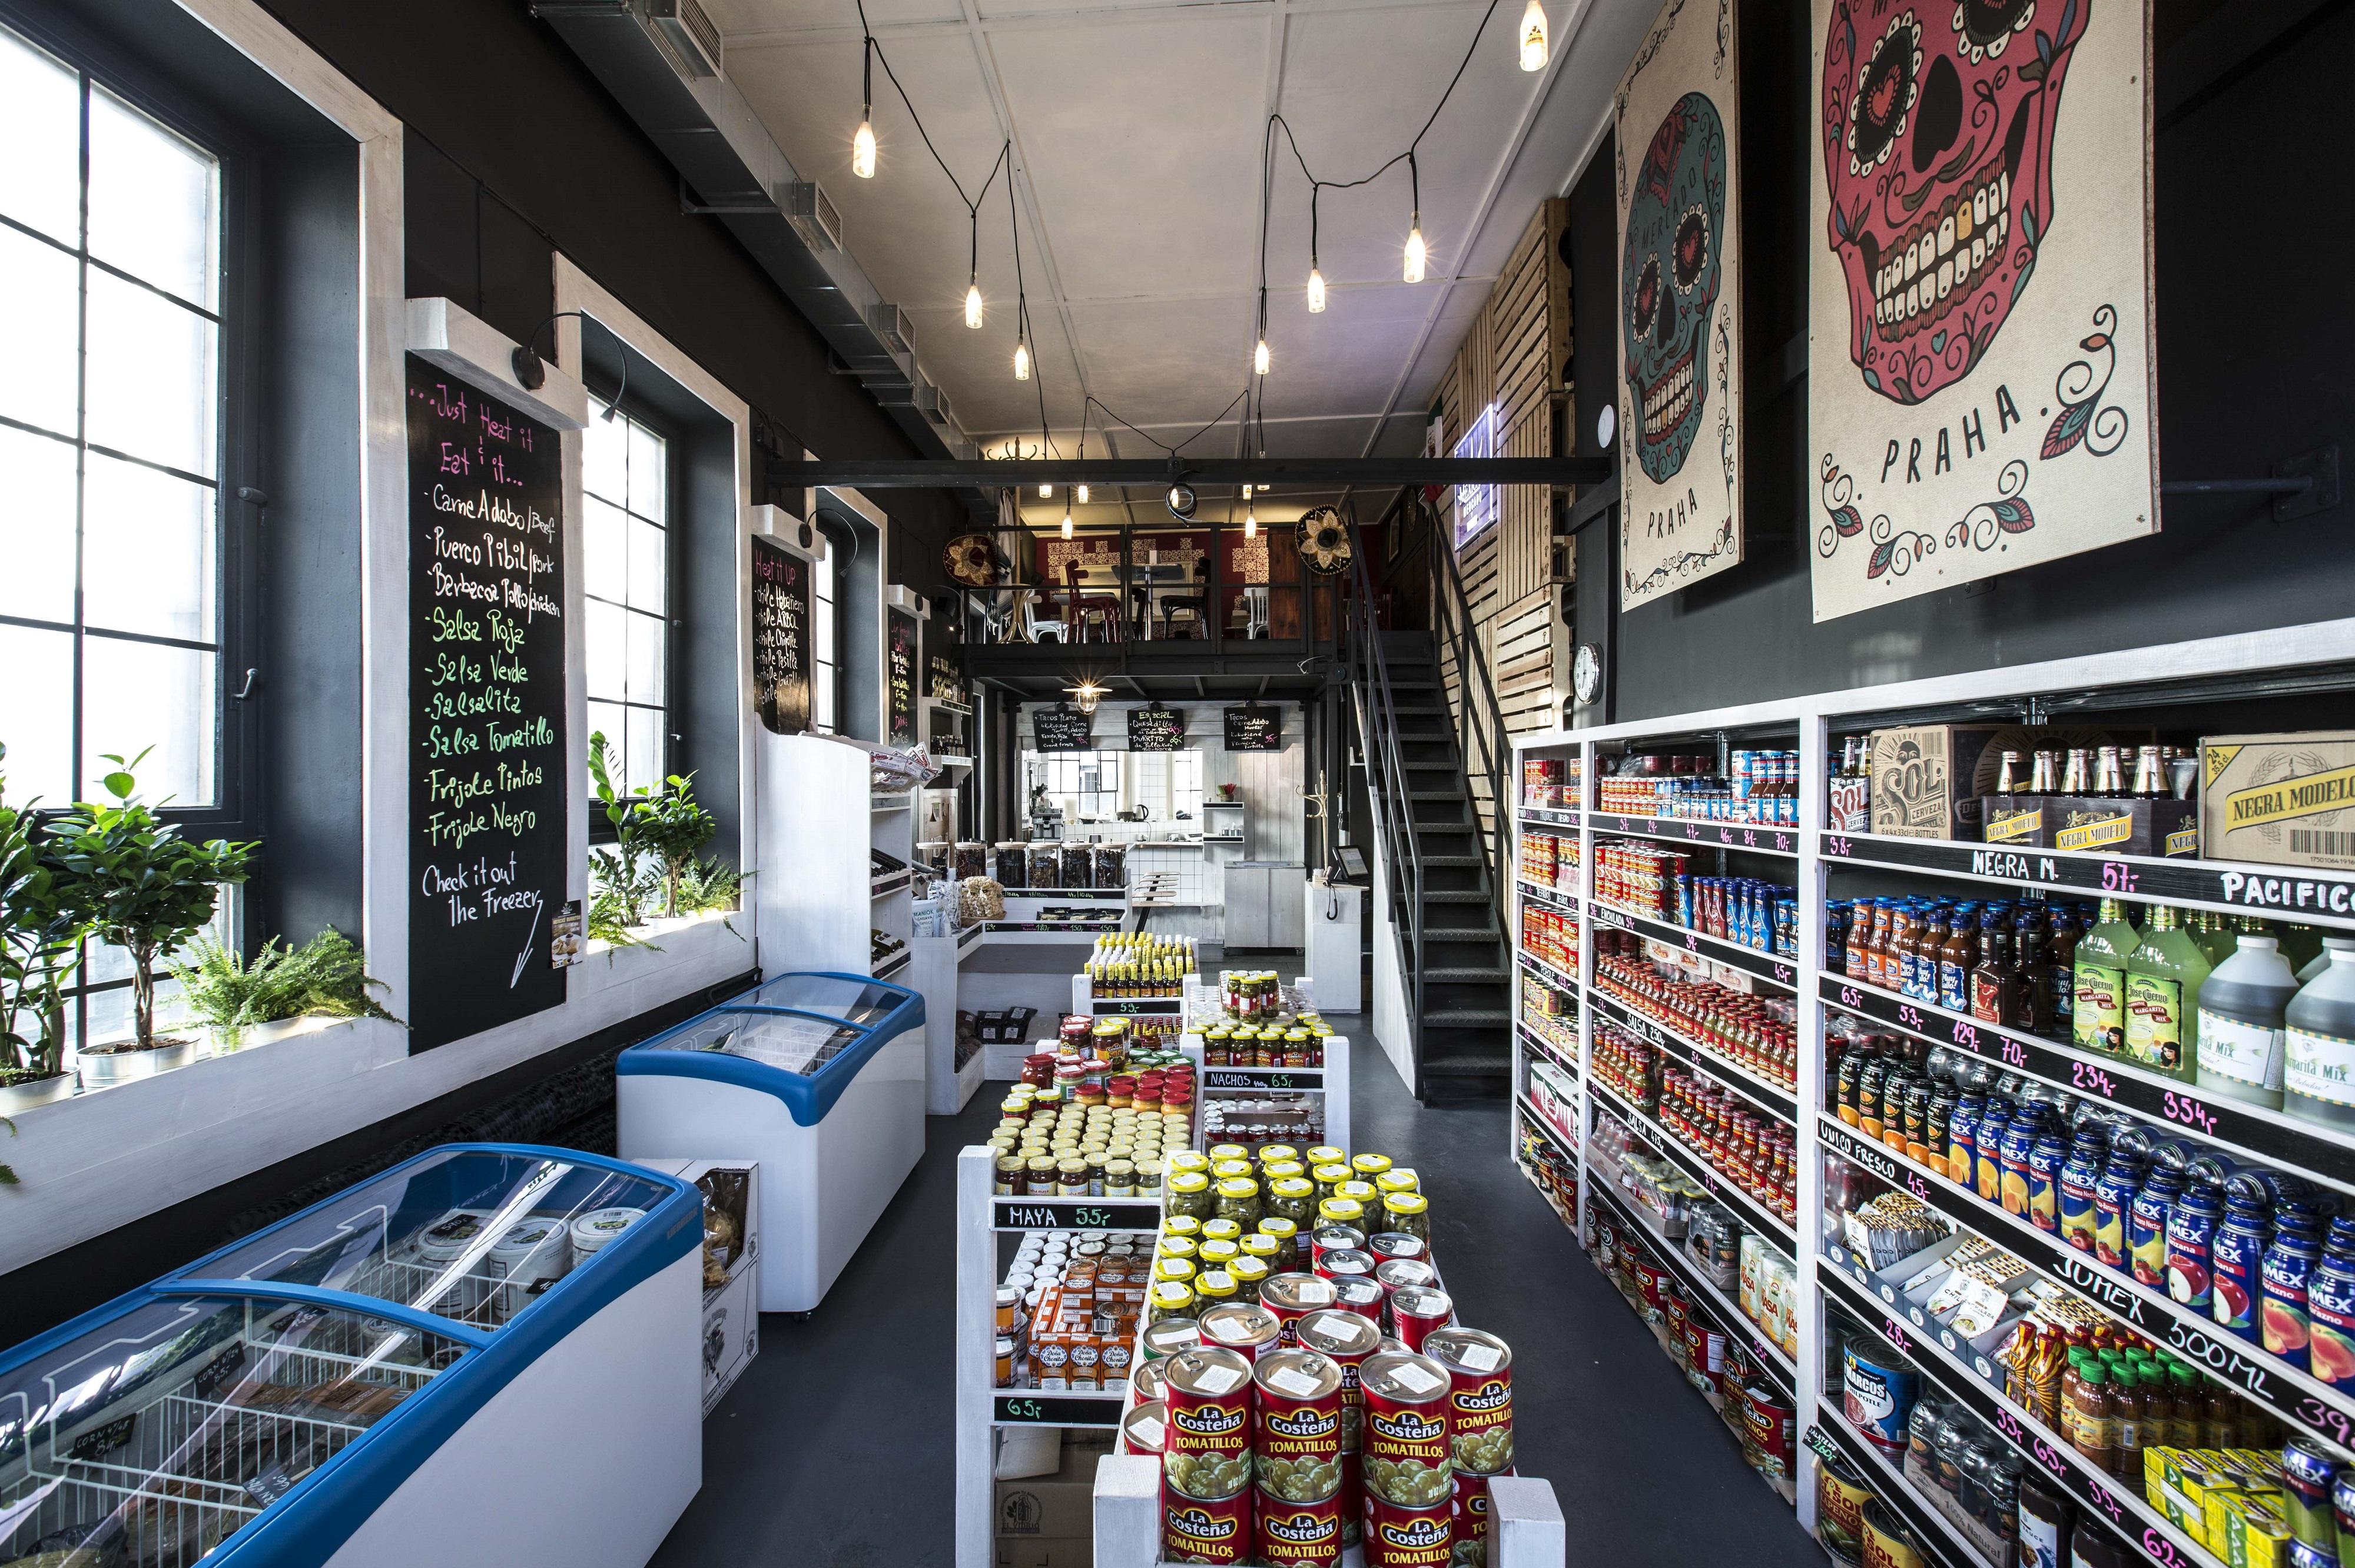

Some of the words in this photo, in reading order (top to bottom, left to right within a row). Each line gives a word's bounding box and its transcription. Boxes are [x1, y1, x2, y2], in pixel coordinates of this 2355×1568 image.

[480, 404, 512, 442] Heat
[520, 428, 532, 452] it
[1882, 384, 2021, 483] PRAHA
[440, 443, 470, 474] Eat
[1647, 487, 1698, 538] PRAHA
[755, 549, 775, 580] Heat
[487, 610, 525, 653] Roja
[490, 650, 528, 682] Verde
[486, 716, 553, 752] Tomatillo
[2208, 749, 2220, 763] 24
[497, 760, 542, 792] Pintos
[1875, 757, 1943, 826] SOL
[1830, 784, 1869, 831] SOL
[1912, 805, 1942, 819] CERVEZA
[2233, 792, 2285, 821] NEGRA
[492, 802, 535, 836] Negro
[1988, 824, 2009, 837] NEGRA
[2011, 816, 2036, 831] MODELO
[1915, 829, 1939, 838] BOTTLES
[2060, 831, 2087, 847] NEGRA
[2091, 822, 2125, 841] MODELO
[2170, 835, 2196, 850] NEGR
[423, 863, 468, 896] Check
[473, 857, 486, 885] it
[490, 851, 516, 883] out
[1972, 850, 2029, 879] NEGRA
[482, 888, 539, 918] Freezer
[1601, 909, 1625, 926] ENCHILADA
[2089, 978, 2114, 991] Cuervo
[2128, 985, 2142, 997] Jose
[2142, 989, 2169, 1004] Cuervo
[2081, 994, 2111, 1002] MARGARITA
[1627, 1014, 1647, 1037] SALSA
[2215, 1041, 2234, 1058] Mix
[1211, 1074, 1251, 1086] NACHOS
[2323, 1064, 2347, 1082] Mix
[1627, 1112, 1647, 1136] SALSA
[1820, 1121, 1851, 1153] UNICO
[1855, 1144, 1895, 1178] FRESCO
[1010, 1207, 1057, 1227] MAYA
[2147, 1220, 2162, 1231] Nectar
[1741, 1271, 1755, 1293] MASA
[2052, 1250, 2145, 1324] JUMEX
[197, 1361, 220, 1383] CORN
[1846, 1366, 1885, 1398] MARCOS
[1486, 1385, 1500, 1396] La
[1847, 1384, 1882, 1408] CHILPOTLE
[1178, 1412, 1241, 1432] Costeña
[1203, 1408, 1219, 1418] La
[1299, 1411, 1314, 1423] La
[1401, 1414, 1418, 1426] La
[1271, 1416, 1336, 1435] Costeña
[1375, 1417, 1440, 1439] Costeña
[77, 1431, 104, 1448] CORN
[1175, 1437, 1243, 1449] TOMATILLOS
[1269, 1440, 1337, 1453] TOMATILLOS
[1373, 1441, 1444, 1457] TOMATILLOS
[1168, 1511, 1230, 1537] Costeña
[1190, 1511, 1206, 1523] La
[1296, 1517, 1312, 1528] La
[1415, 1521, 1430, 1533] La
[1269, 1520, 1334, 1540] Costeña
[1385, 1523, 1449, 1544] Costeña
[1945, 1499, 1966, 1527] 100%
[1967, 1525, 2001, 1559] Natural
[1167, 1534, 1234, 1557] TOMATILLOS
[1267, 1544, 1336, 1557] TOMATILLOS
[1384, 1548, 1450, 1564] TOMATILLOS
